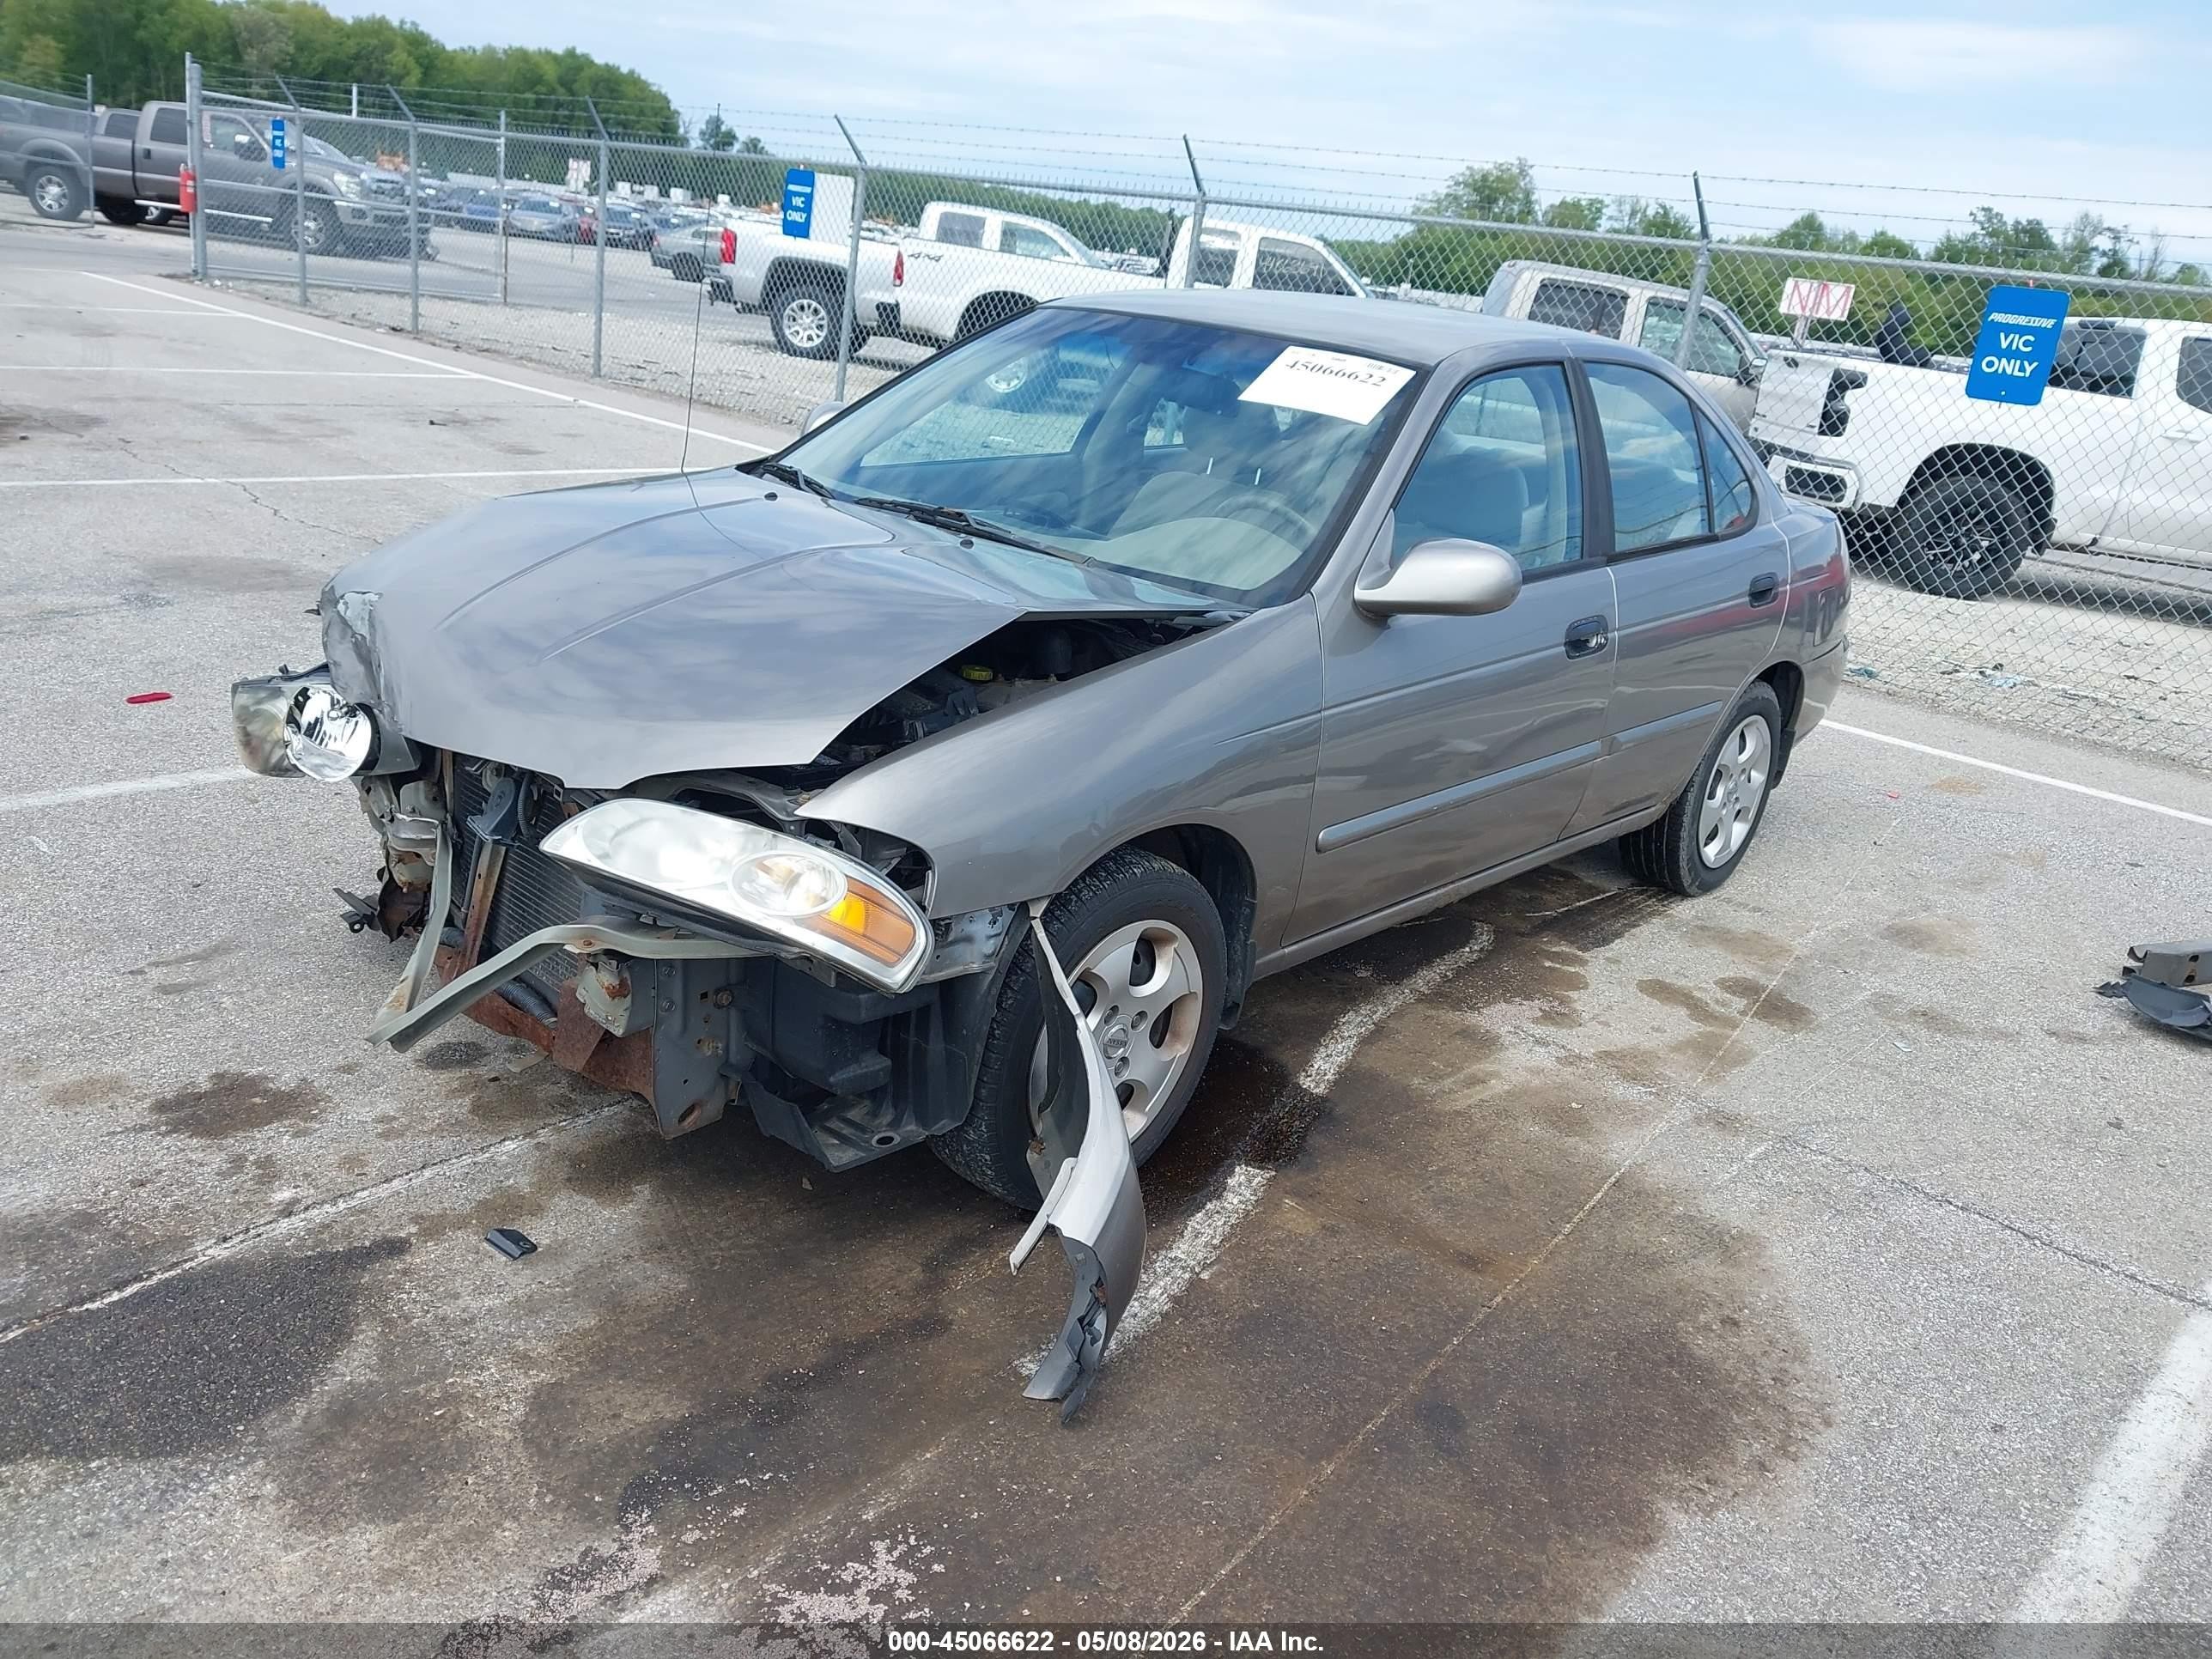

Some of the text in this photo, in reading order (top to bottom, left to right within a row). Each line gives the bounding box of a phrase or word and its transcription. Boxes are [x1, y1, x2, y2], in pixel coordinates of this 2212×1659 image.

[792, 195, 805, 208] VIC
[786, 210, 807, 223] ONLY
[1987, 312, 2057, 329] PROGRESSIVE
[1999, 331, 2036, 352] VIC
[1285, 359, 1388, 387] 45066622
[1981, 356, 2039, 378] ONLY
